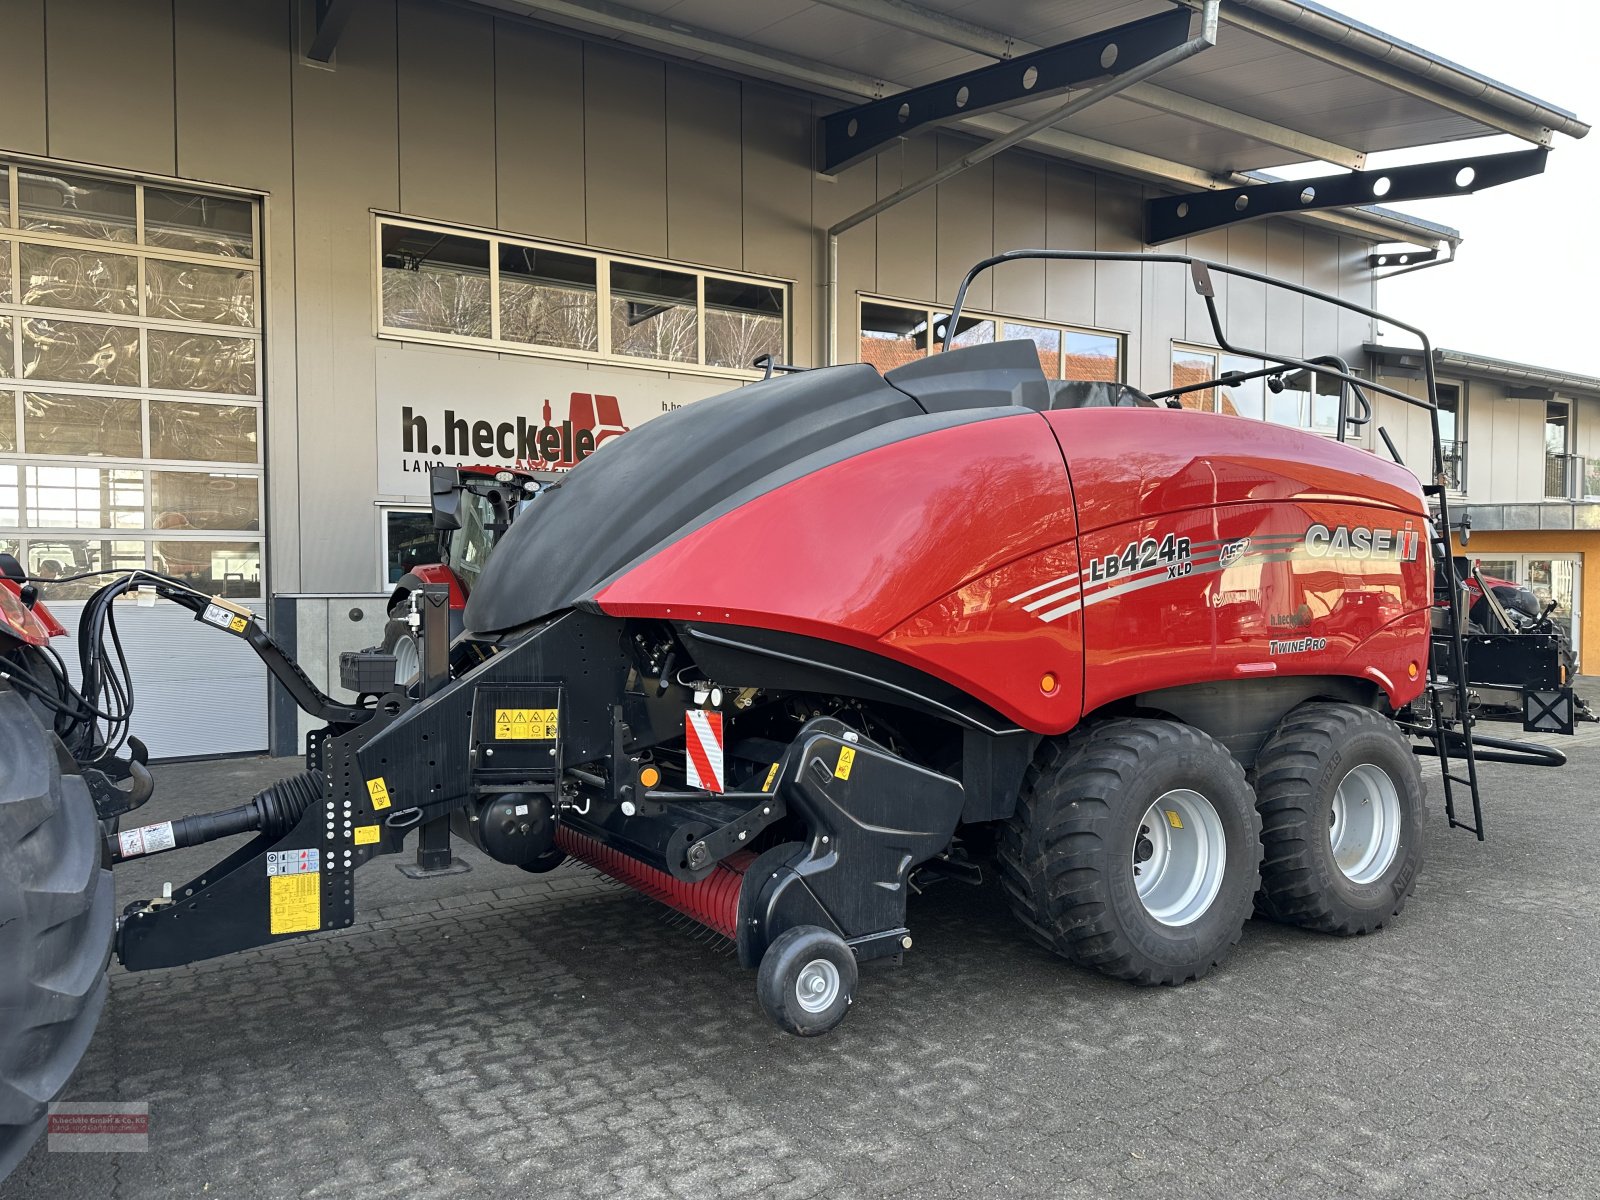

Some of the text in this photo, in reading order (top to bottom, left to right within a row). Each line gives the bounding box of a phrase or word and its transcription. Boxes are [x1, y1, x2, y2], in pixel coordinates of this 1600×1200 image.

[402, 406, 594, 463] h.heckele
[1089, 533, 1191, 582] LB424R
[1305, 523, 1392, 559] CASE
[1167, 561, 1192, 580] XLD
